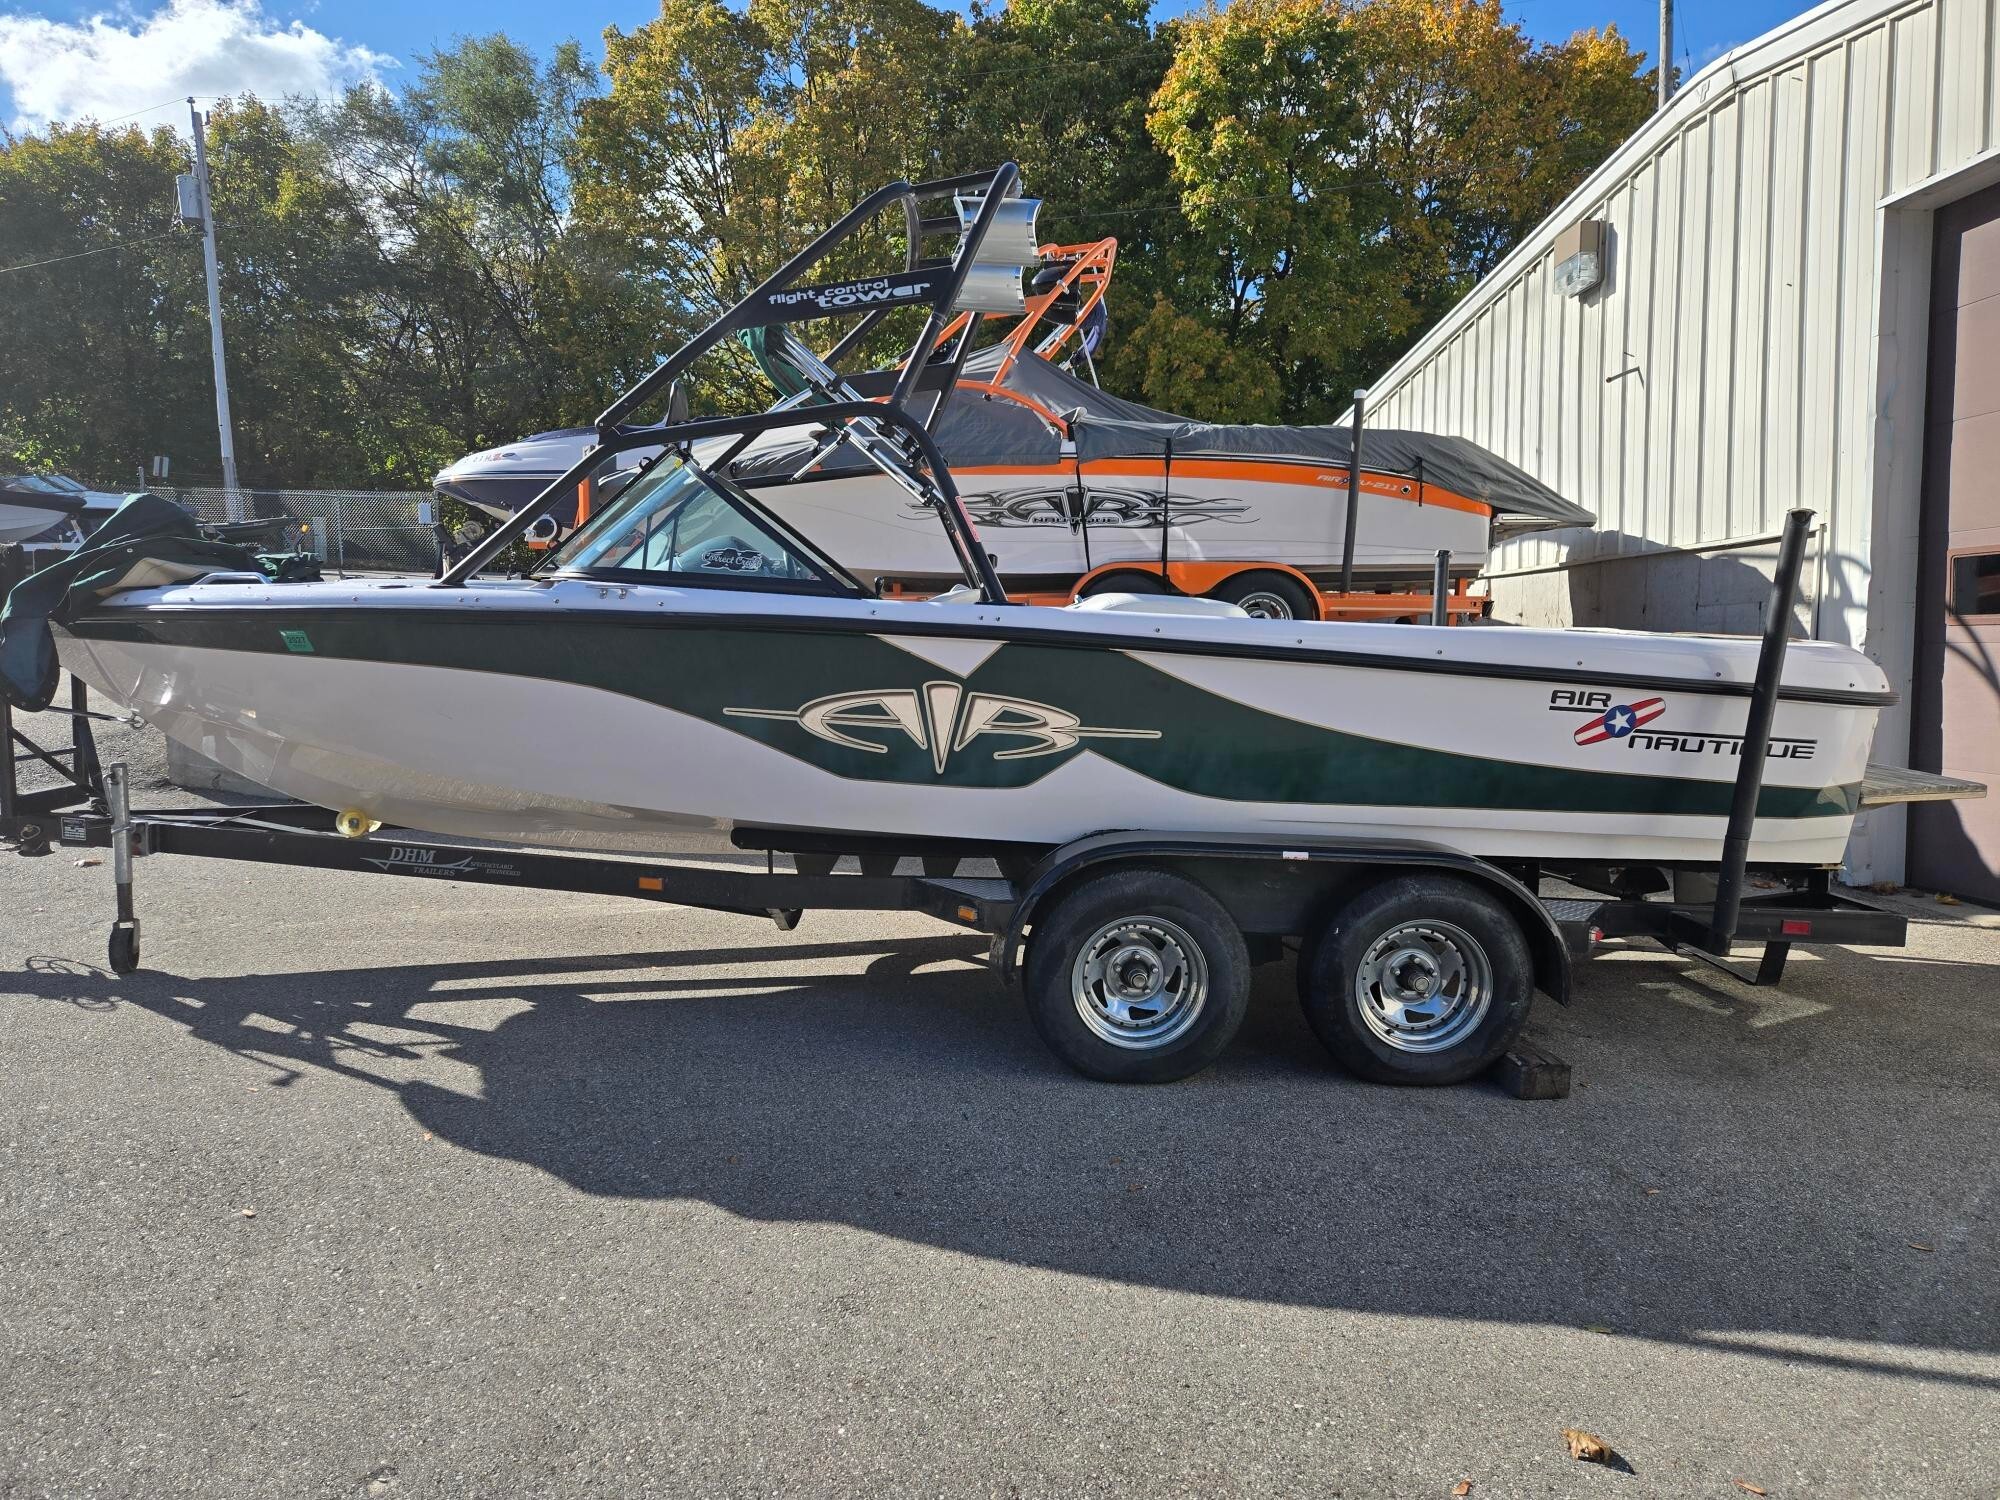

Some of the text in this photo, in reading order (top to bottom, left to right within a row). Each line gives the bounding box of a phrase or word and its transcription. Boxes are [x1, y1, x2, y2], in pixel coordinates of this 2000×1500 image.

[768, 289, 816, 305] flight
[824, 278, 889, 297] control
[814, 282, 932, 308] tower
[701, 551, 735, 565] Correct
[1550, 689, 1613, 708] AIR
[1627, 734, 1816, 760] NAUTIUE
[389, 847, 436, 864] DHM
[414, 867, 456, 877] TRAILERS
